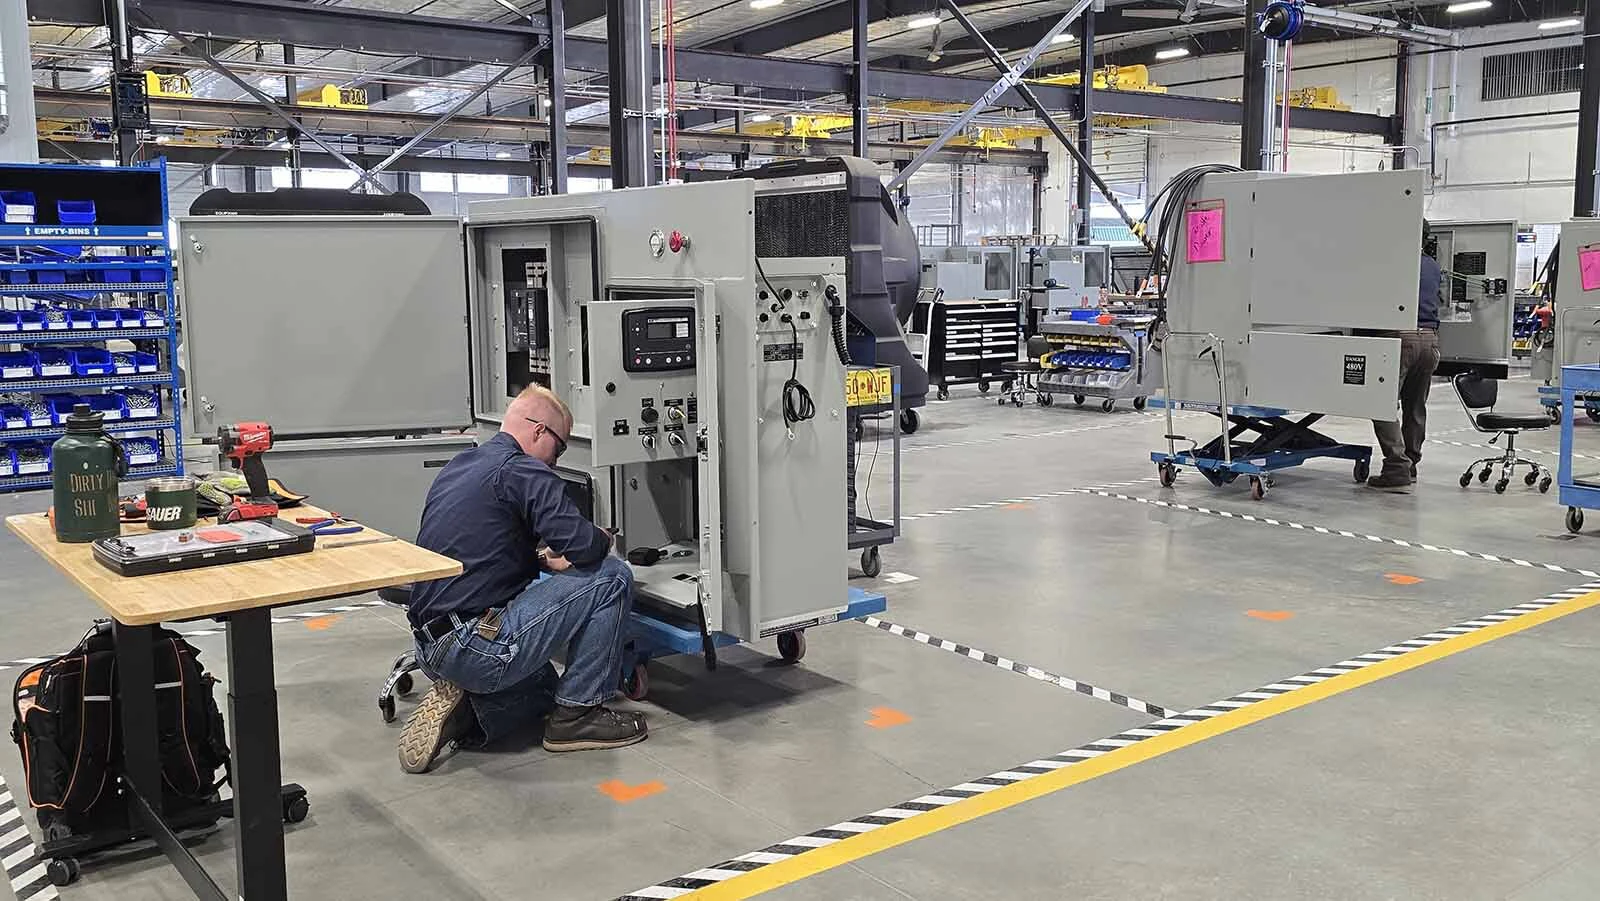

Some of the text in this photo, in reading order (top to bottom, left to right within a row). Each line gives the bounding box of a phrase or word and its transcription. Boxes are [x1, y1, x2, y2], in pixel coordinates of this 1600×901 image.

[34, 226, 91, 236] EMPTY-BINS
[1346, 363, 1364, 371] 480V
[70, 472, 104, 493] DIRTY
[146, 506, 183, 522] SAUER
